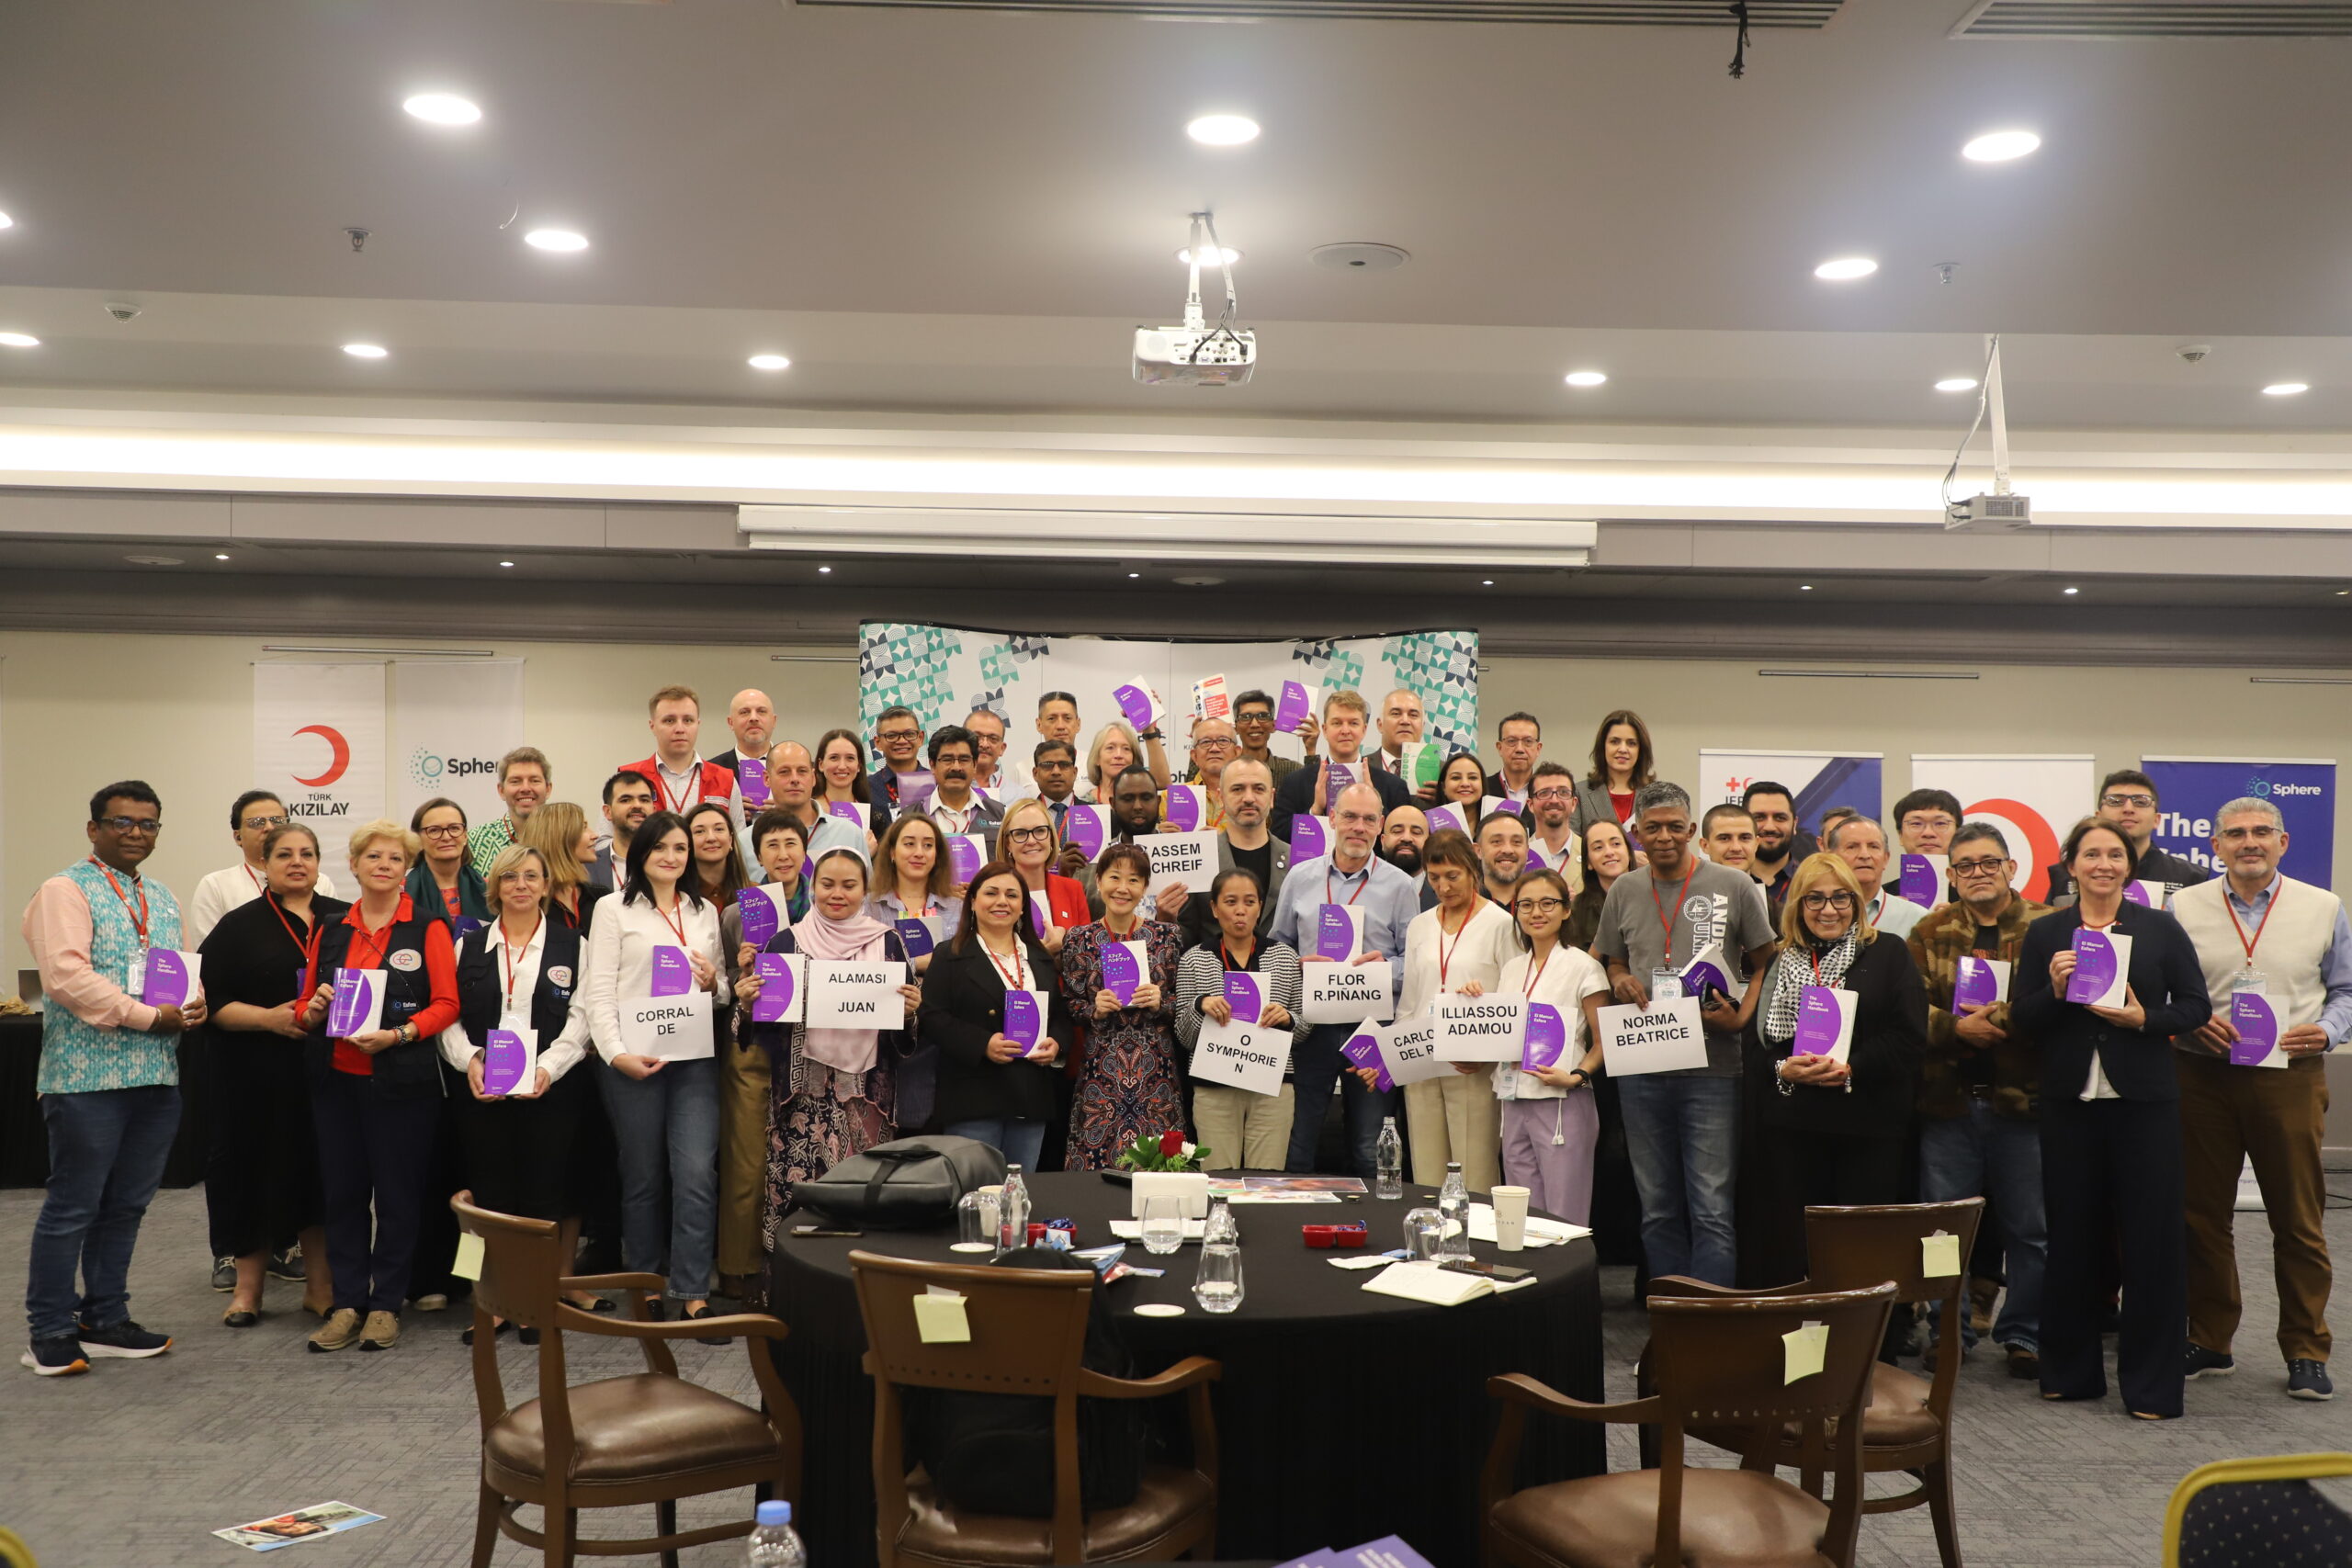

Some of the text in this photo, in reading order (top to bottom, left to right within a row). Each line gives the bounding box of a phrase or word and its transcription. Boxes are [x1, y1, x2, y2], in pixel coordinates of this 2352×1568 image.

[2272, 784, 2322, 796] Sphere
[309, 794, 332, 802] TÜRK
[289, 803, 350, 817] KIZILAY
[2156, 812, 2211, 838] The
[1151, 843, 1201, 858] ASSEM
[1151, 859, 1203, 874] CHREIF
[828, 974, 887, 984] ALAMASI
[1329, 975, 1365, 986] FLOR
[1314, 987, 1382, 1001] R.PIÑANG
[838, 1002, 875, 1013] JUAN
[1442, 1006, 1517, 1019] ILLIASSOU
[636, 1006, 695, 1023] CORRAL
[1623, 1012, 1678, 1030] NORMA
[657, 1023, 676, 1035] DE
[1448, 1022, 1512, 1035] ADAMOU
[1240, 1034, 1251, 1046] O
[1615, 1027, 1690, 1046] BEATRICE
[1206, 1043, 1278, 1067] SYMPHORIE
[1399, 1047, 1424, 1061] DEL
[1234, 1063, 1244, 1073] N
